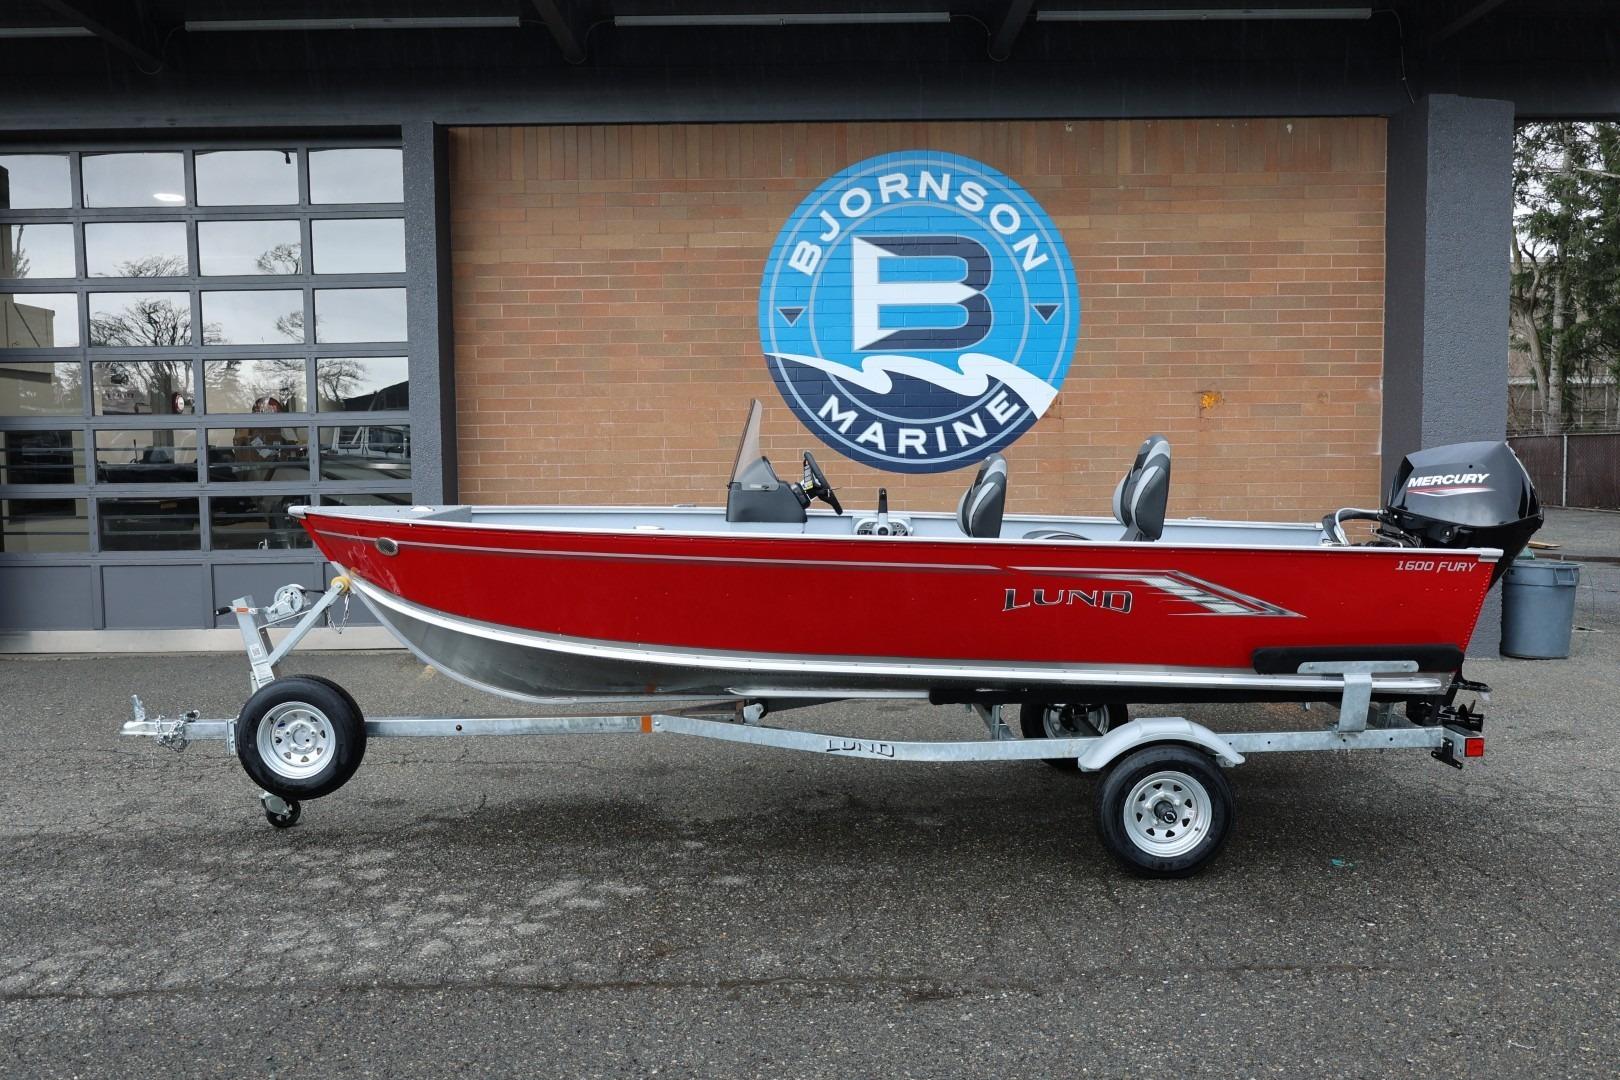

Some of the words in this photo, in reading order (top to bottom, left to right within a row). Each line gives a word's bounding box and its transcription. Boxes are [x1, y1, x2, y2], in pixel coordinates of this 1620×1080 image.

[788, 171, 1049, 276] BJORNSON
[817, 389, 1021, 455] MARINE
[1407, 473, 1490, 487] MERCURY
[1395, 560, 1435, 571] 1600
[1436, 561, 1477, 573] FURY
[1002, 588, 1133, 614] LUND
[826, 739, 895, 757] LUND
